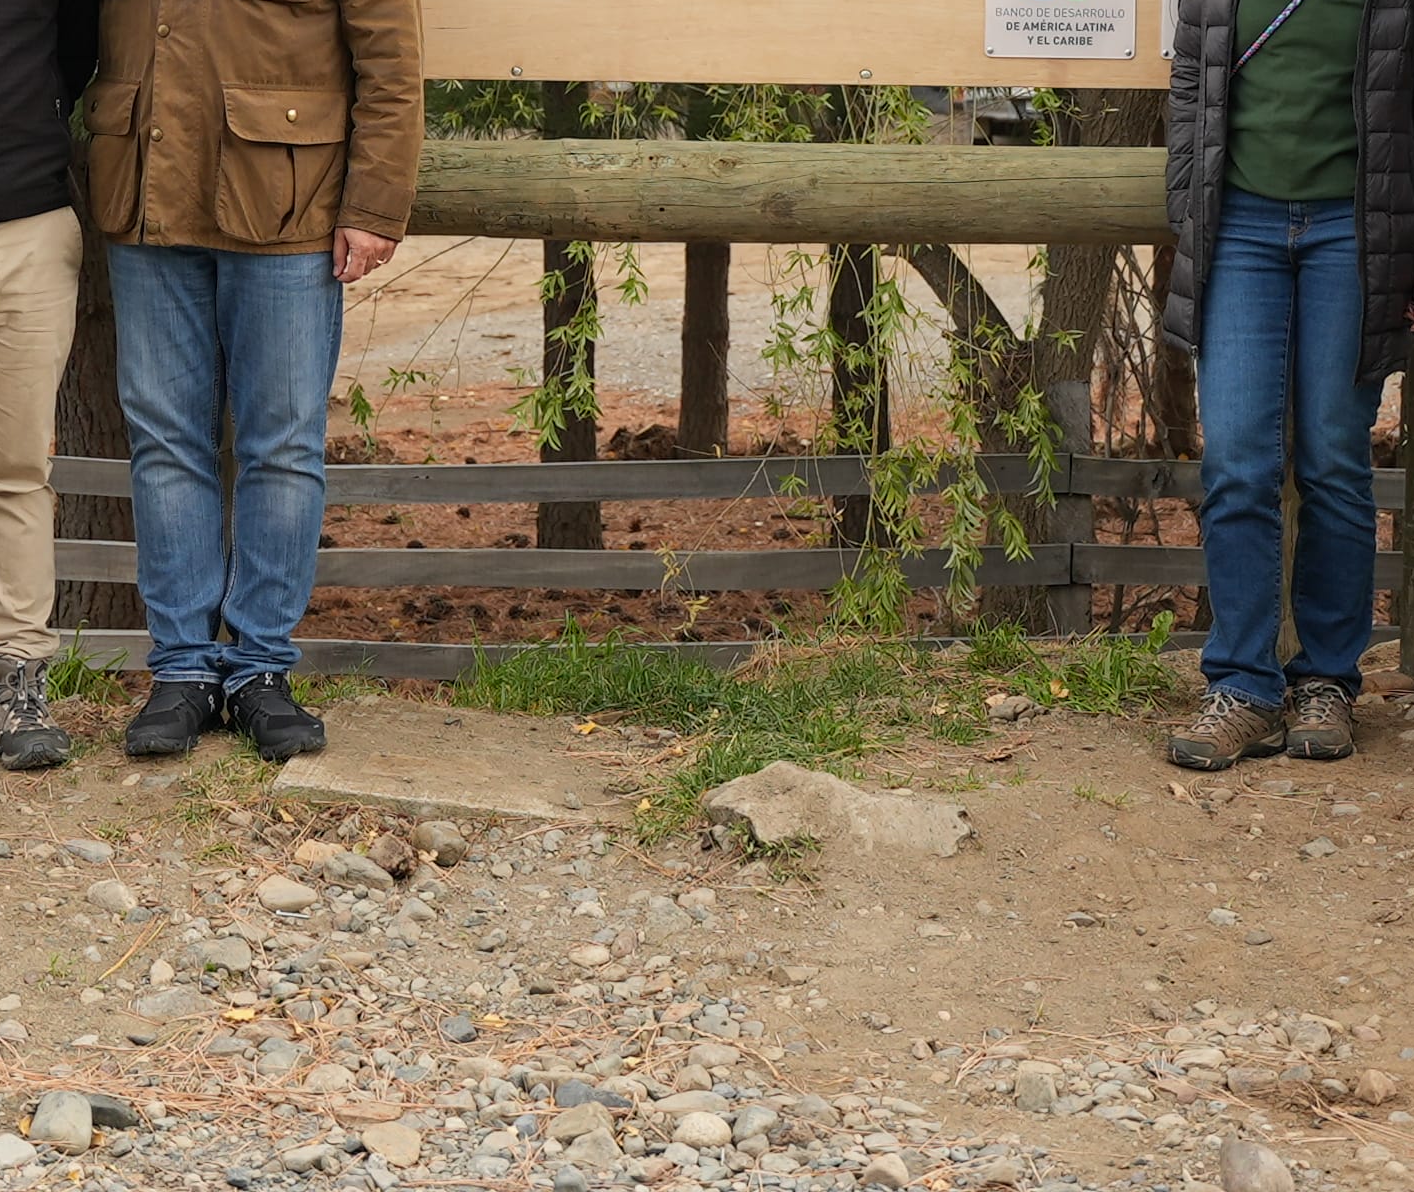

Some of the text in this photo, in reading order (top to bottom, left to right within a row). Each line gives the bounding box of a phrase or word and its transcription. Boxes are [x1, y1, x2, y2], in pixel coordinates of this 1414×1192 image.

[995, 7, 1126, 19] BANCO DE DESARROLLO
[1005, 19, 1115, 32] DE AMÉRICA LATINA
[1027, 36, 1094, 46] Y EL CARIBE
